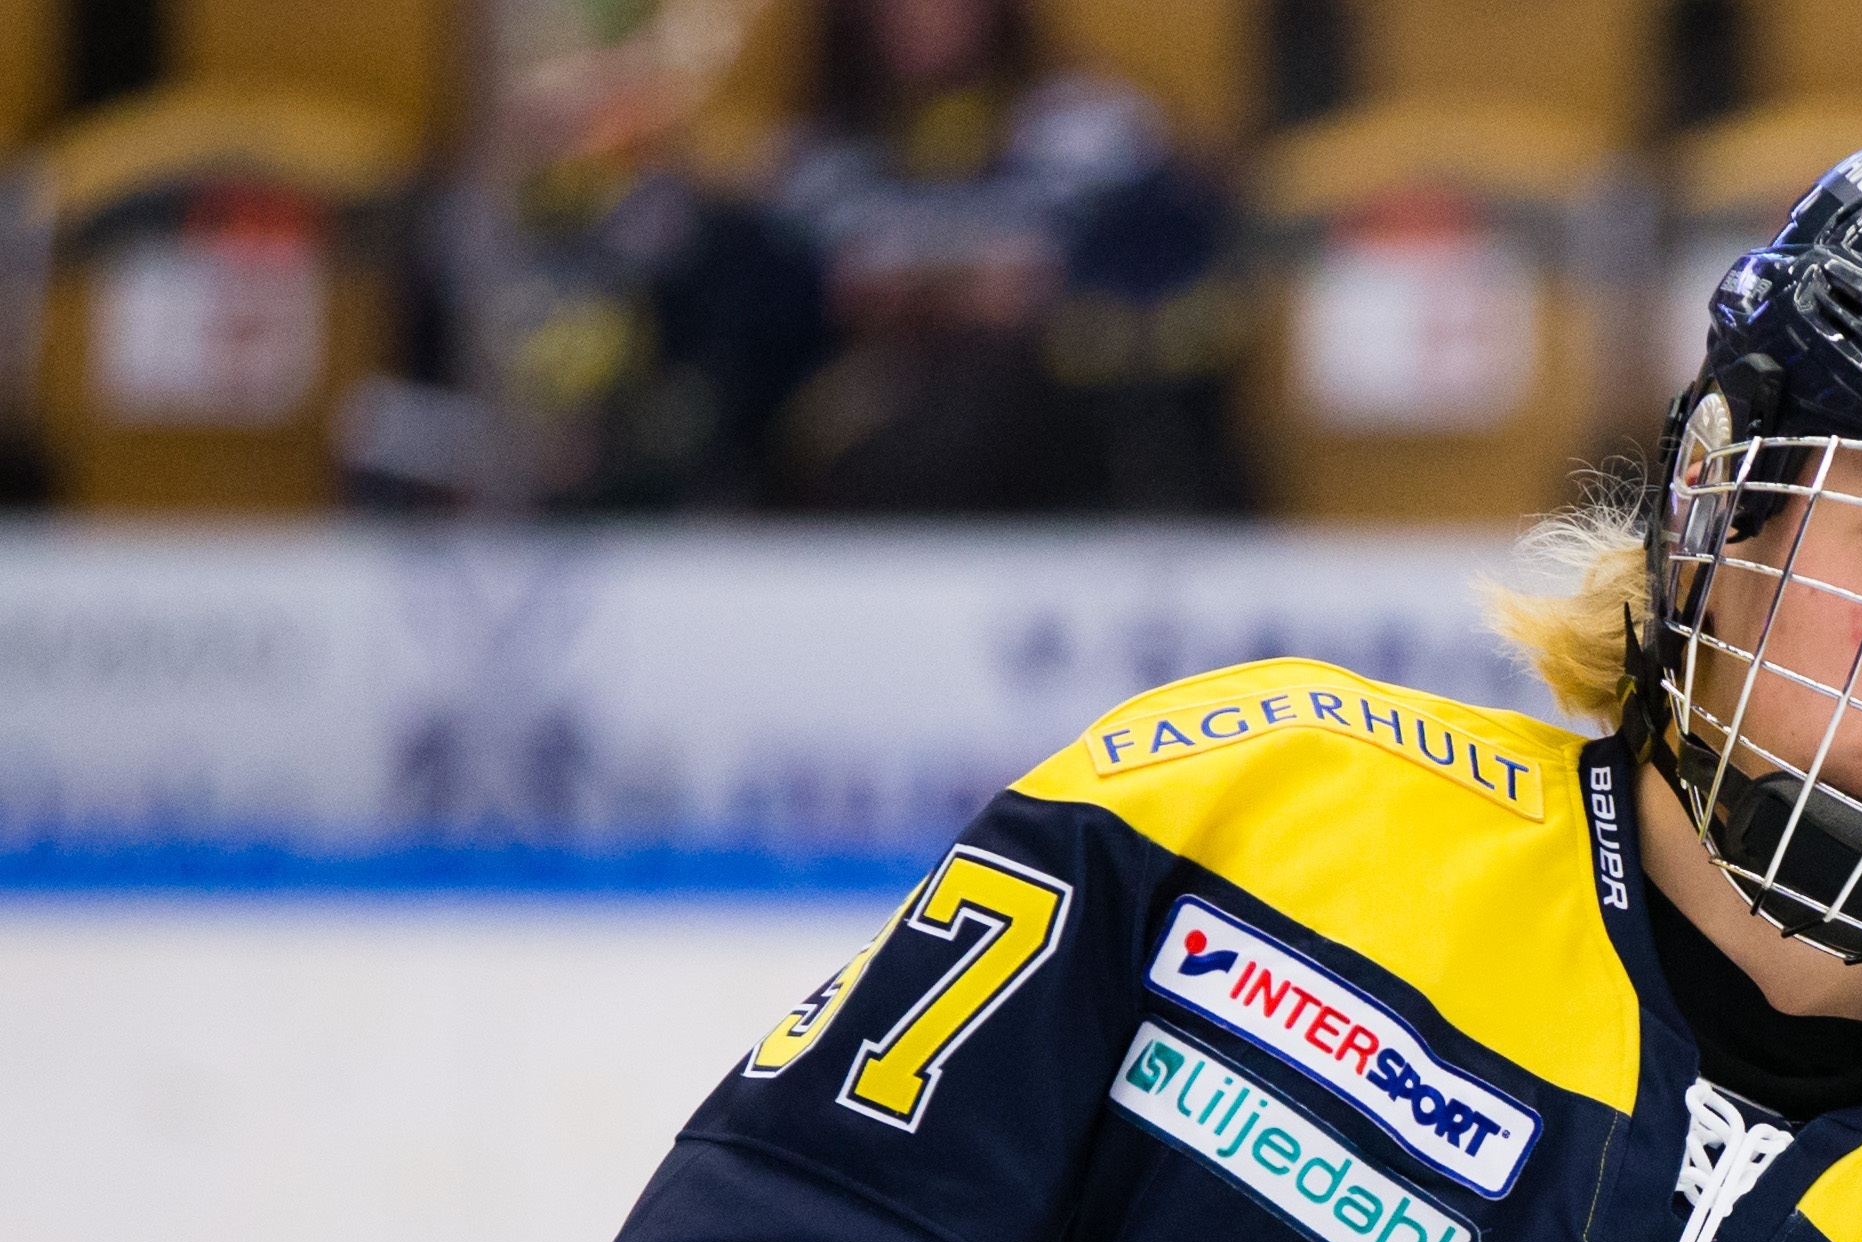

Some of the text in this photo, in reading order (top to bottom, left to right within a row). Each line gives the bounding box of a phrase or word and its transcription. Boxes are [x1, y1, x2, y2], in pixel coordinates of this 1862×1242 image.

[1101, 690, 1530, 803] FAGERHULT
[1589, 765, 1629, 912] BAUER
[1229, 960, 1503, 1158] INTERSPORT
